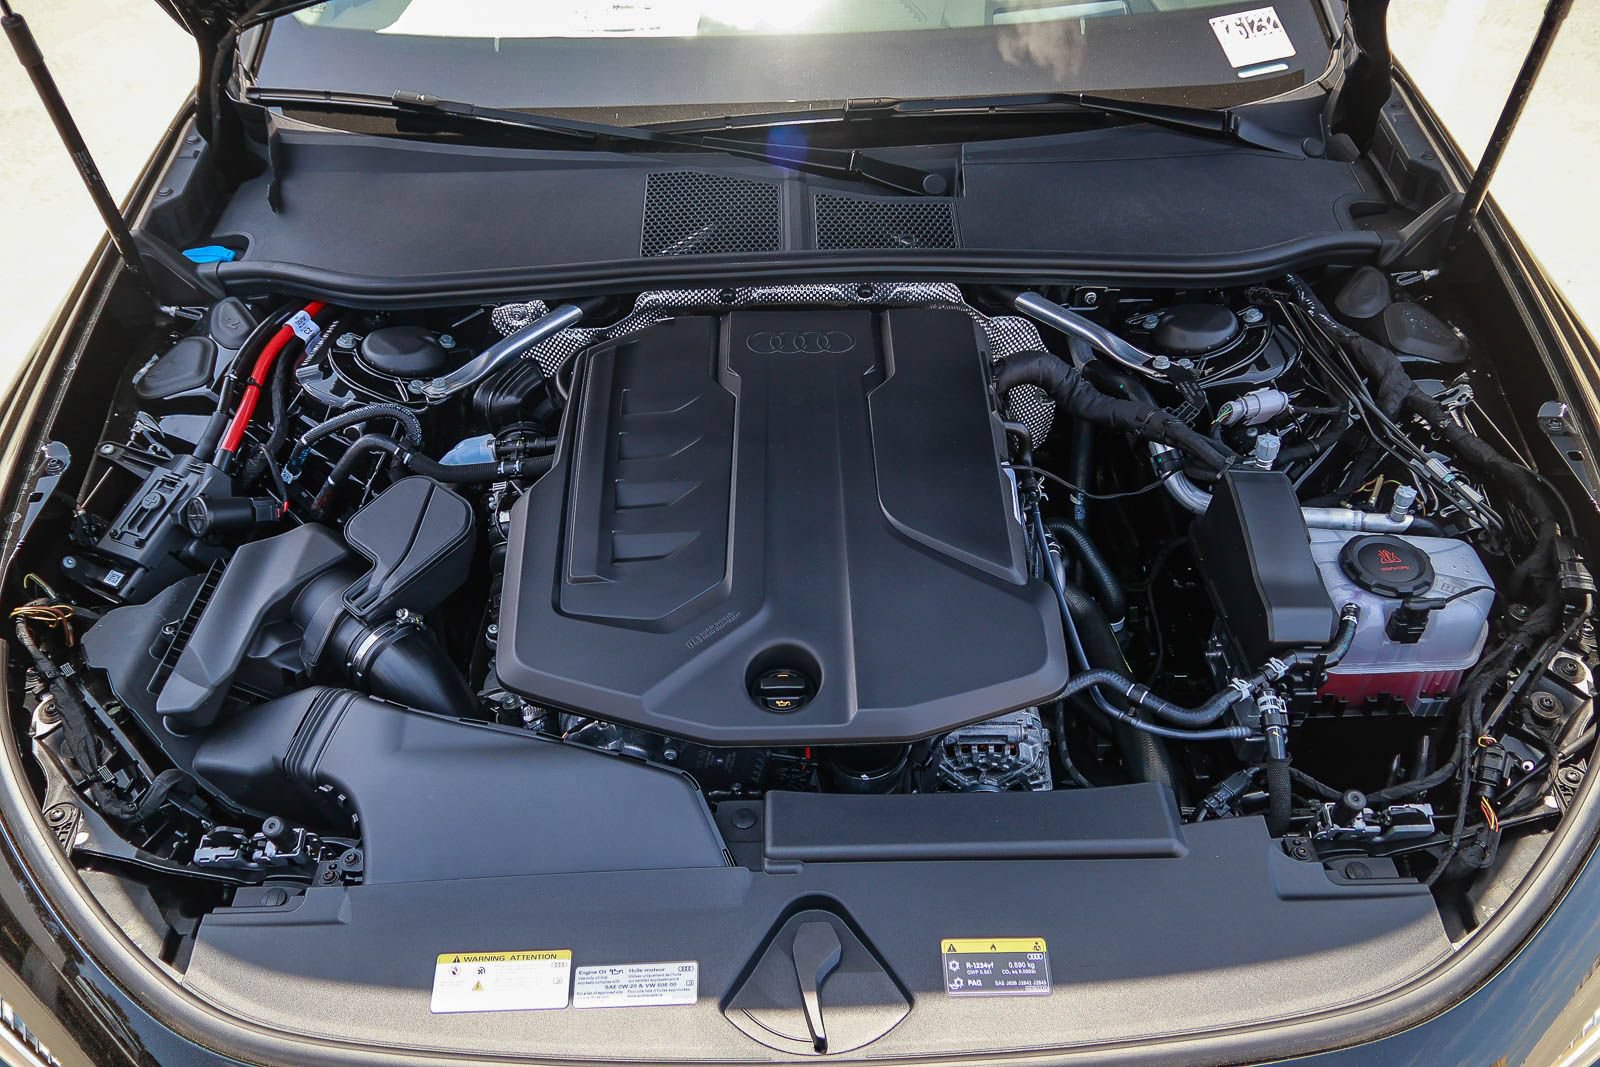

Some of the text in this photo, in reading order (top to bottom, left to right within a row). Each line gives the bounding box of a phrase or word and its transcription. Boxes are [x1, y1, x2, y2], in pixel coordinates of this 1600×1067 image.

[509, 953, 557, 961] ATTENTION
[966, 962, 994, 970] R-1234yf
[1028, 961, 1035, 970] kg
[967, 979, 982, 987] PAG
